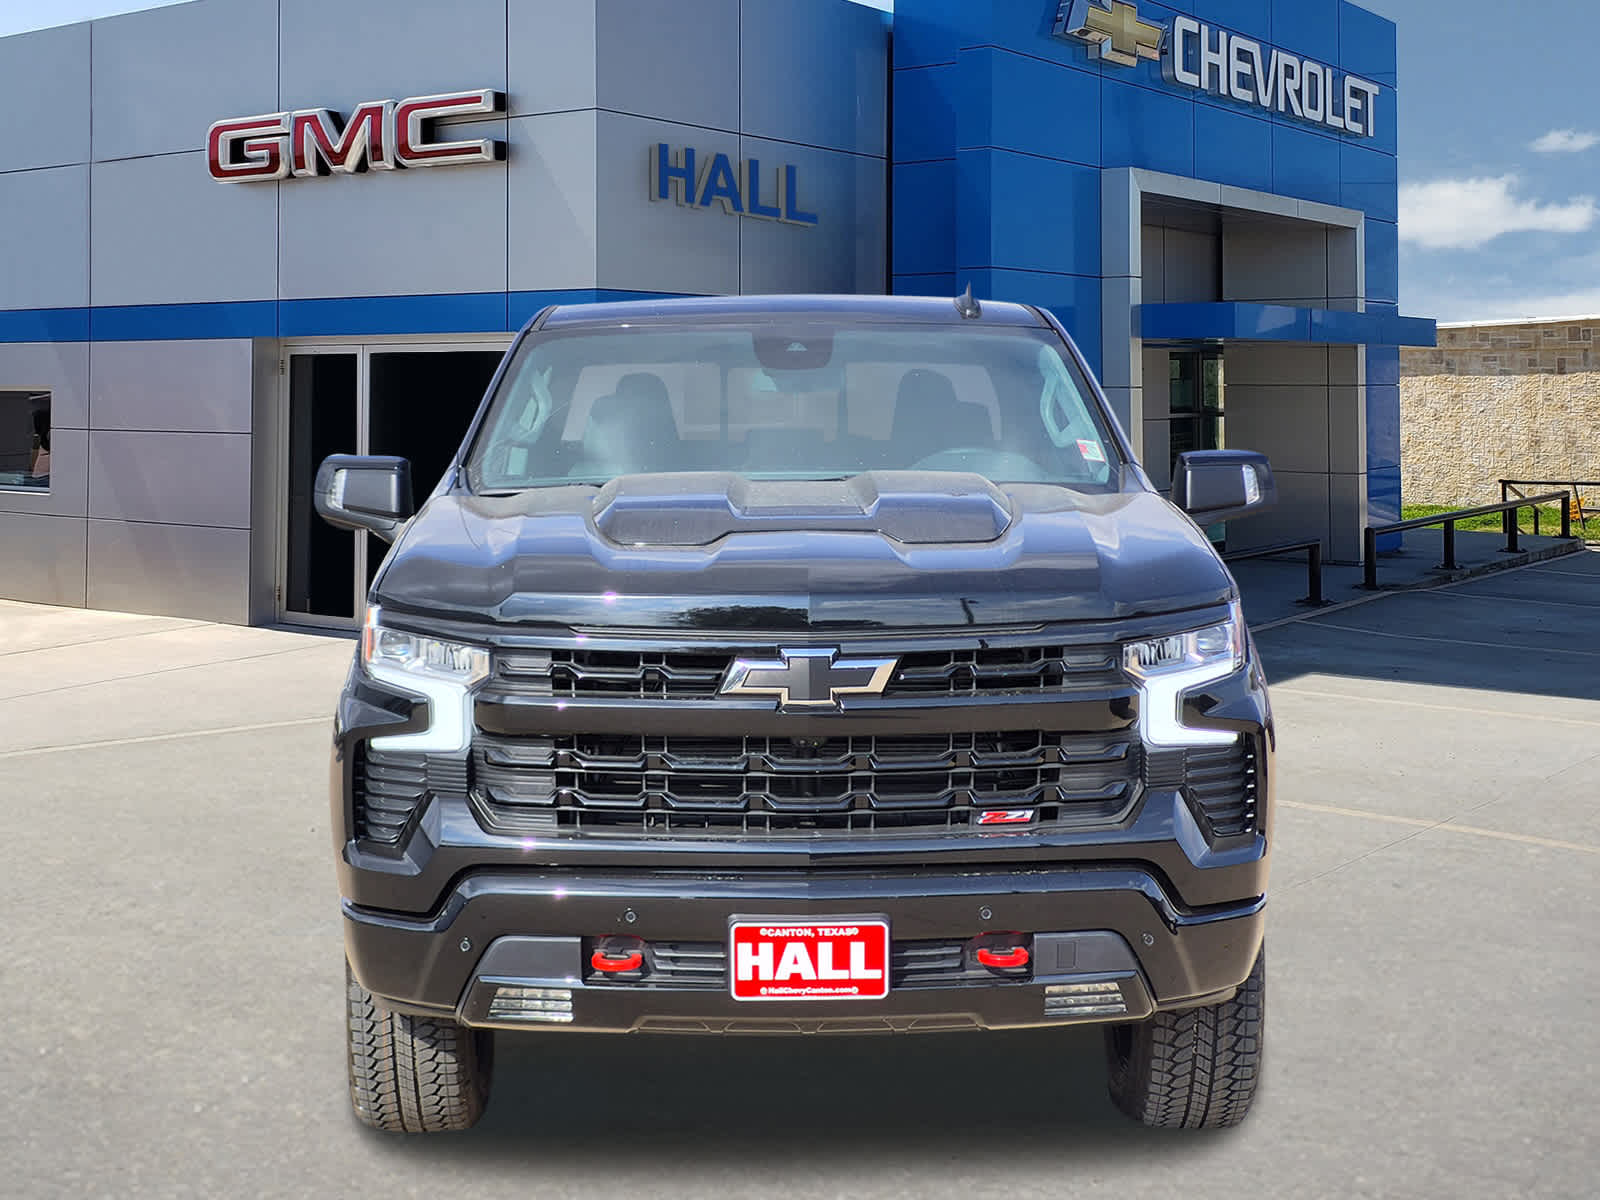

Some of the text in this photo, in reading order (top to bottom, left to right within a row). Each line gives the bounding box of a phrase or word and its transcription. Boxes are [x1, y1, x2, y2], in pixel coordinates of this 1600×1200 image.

[1170, 15, 1380, 137] CHEVROLET
[205, 88, 506, 184] GMC
[655, 142, 819, 225] HALL
[737, 941, 882, 981] HALL
[768, 927, 852, 938] CANTON, TEXAS
